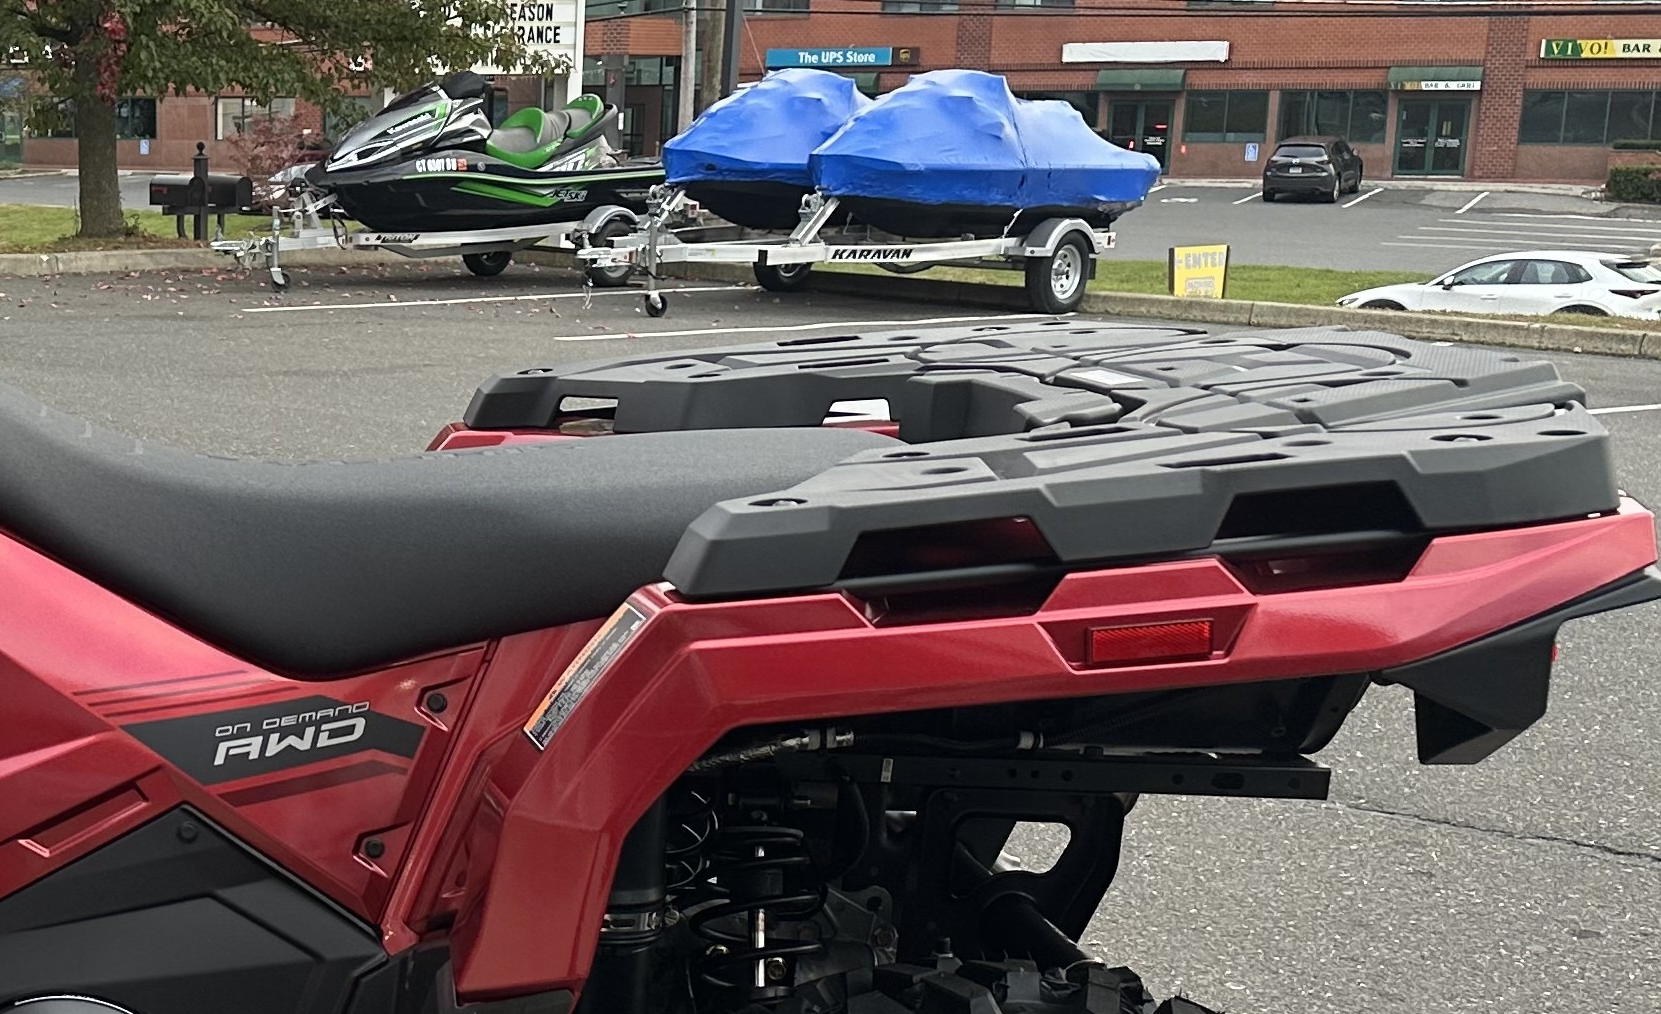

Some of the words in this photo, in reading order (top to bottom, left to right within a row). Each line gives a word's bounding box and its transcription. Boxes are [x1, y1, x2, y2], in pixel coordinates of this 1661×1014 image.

[1551, 41, 1608, 55] VIVO!
[1622, 43, 1651, 53] BAR
[798, 52, 818, 63] The
[821, 50, 843, 63] UPS
[846, 50, 875, 62] Store
[831, 248, 914, 260] KARAVAN
[215, 722, 251, 737] ON
[262, 701, 370, 730] DEMAND
[213, 716, 366, 766] AWD
